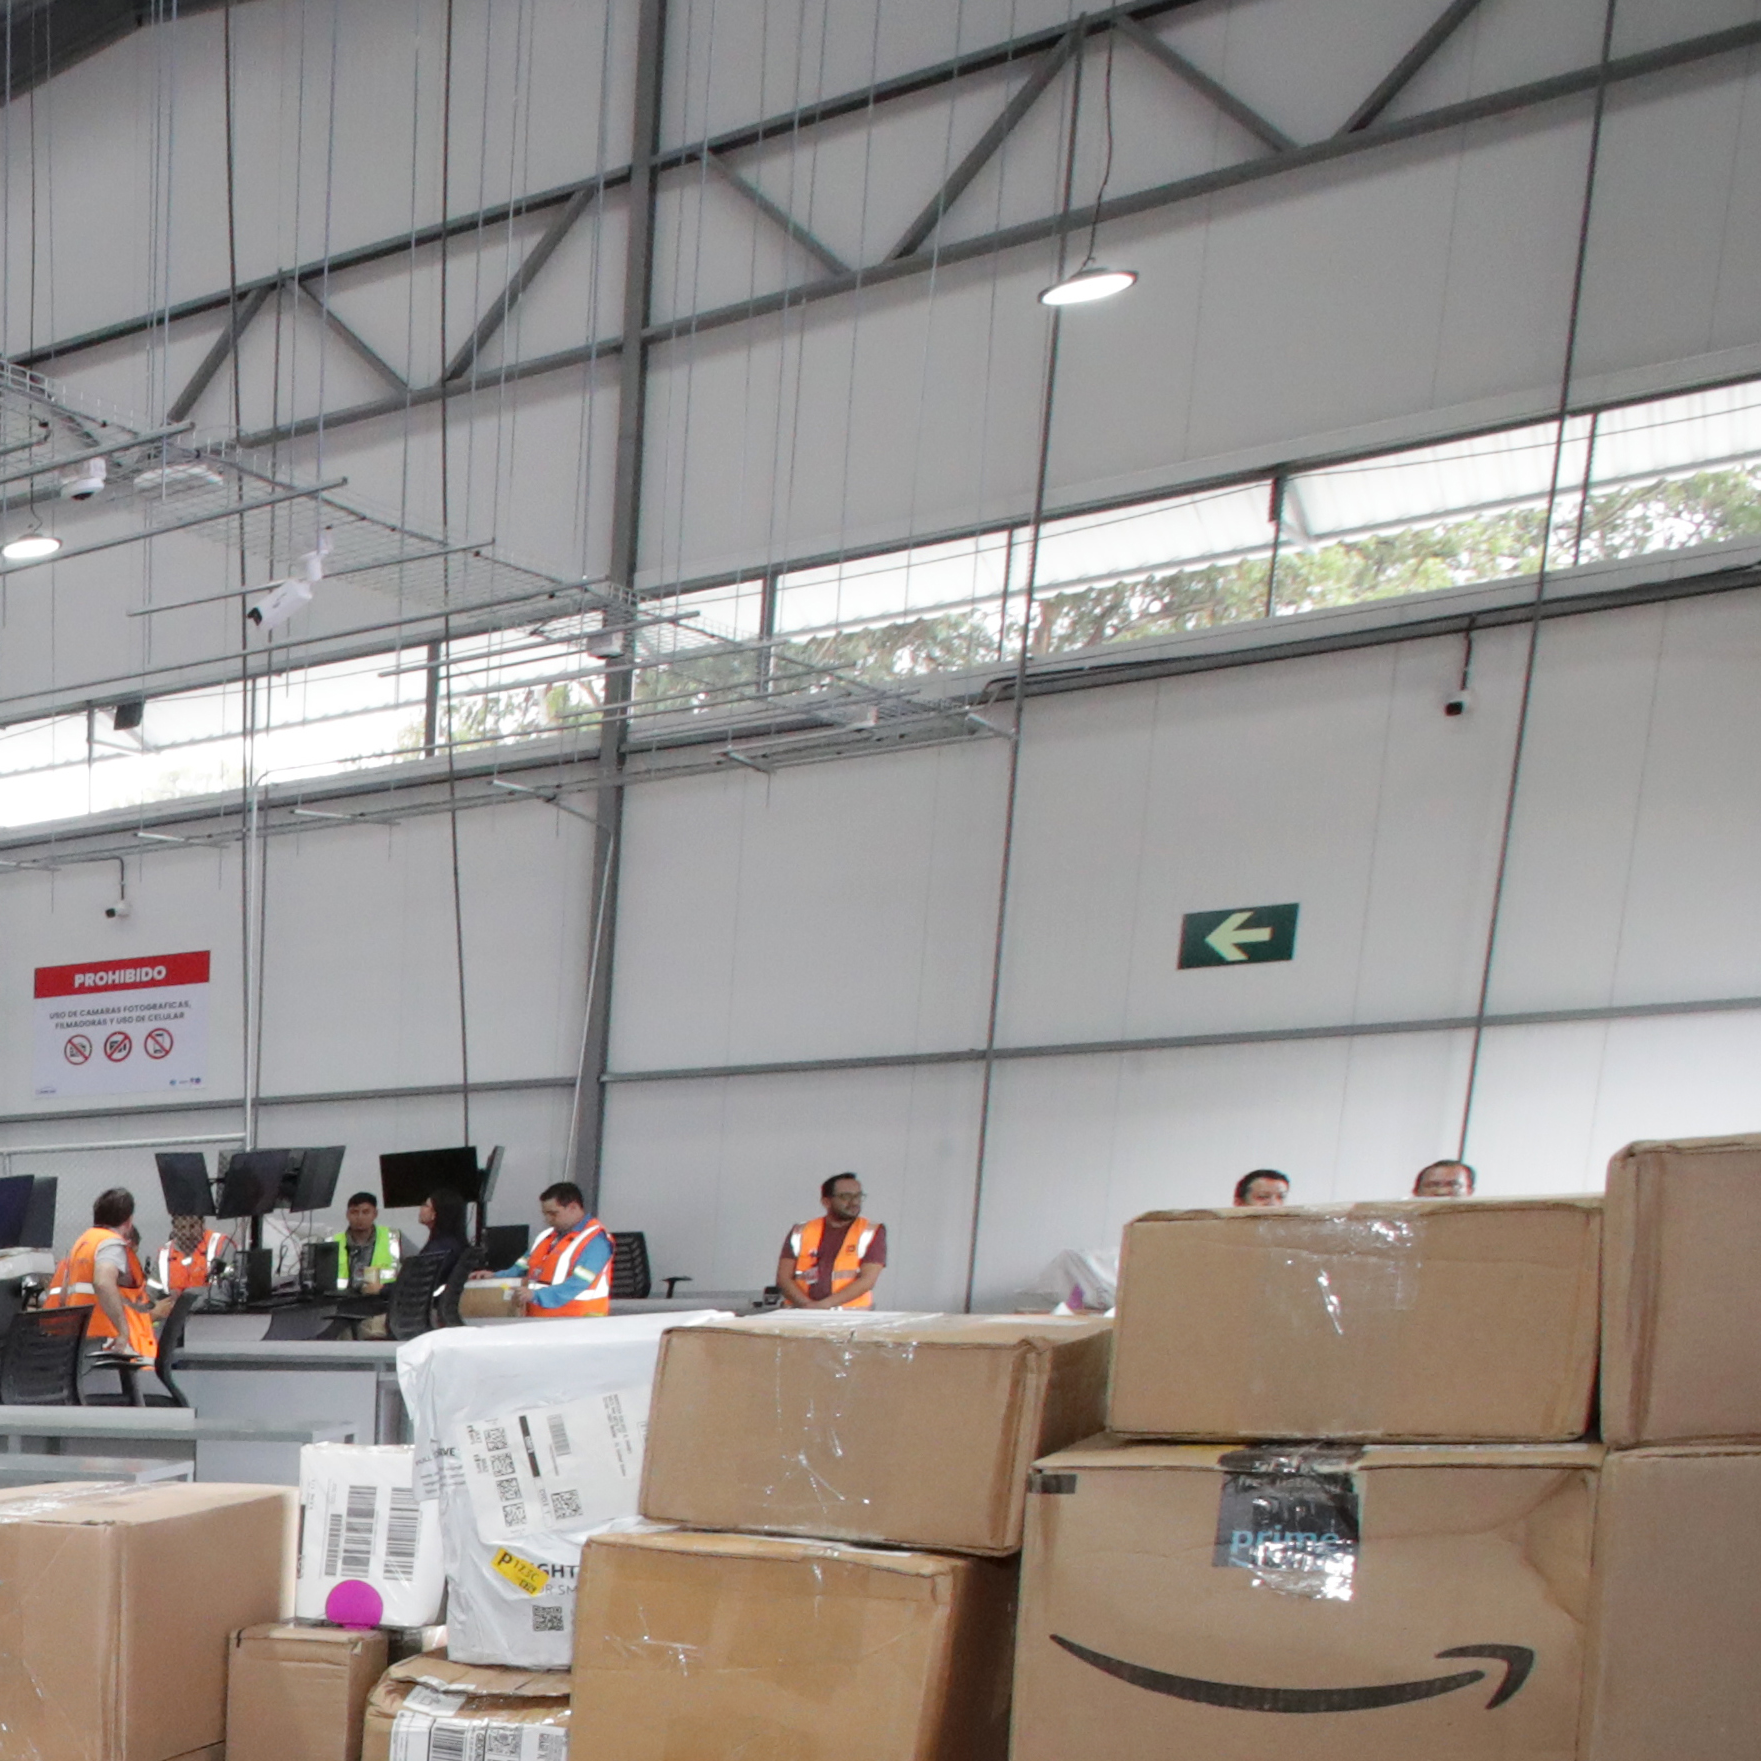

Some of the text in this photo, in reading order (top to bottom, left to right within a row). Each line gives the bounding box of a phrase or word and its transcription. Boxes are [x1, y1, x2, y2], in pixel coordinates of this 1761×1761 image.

[74, 965, 166, 988] PROHIBIDO
[49, 1010, 66, 1019] USO
[68, 1009, 78, 1018] DE
[79, 1006, 121, 1017] CAMARAS
[55, 1011, 185, 1030] FILMADORAS Y USO DE CELULAR
[1230, 1524, 1341, 1556] prime
[497, 1552, 512, 1567] P
